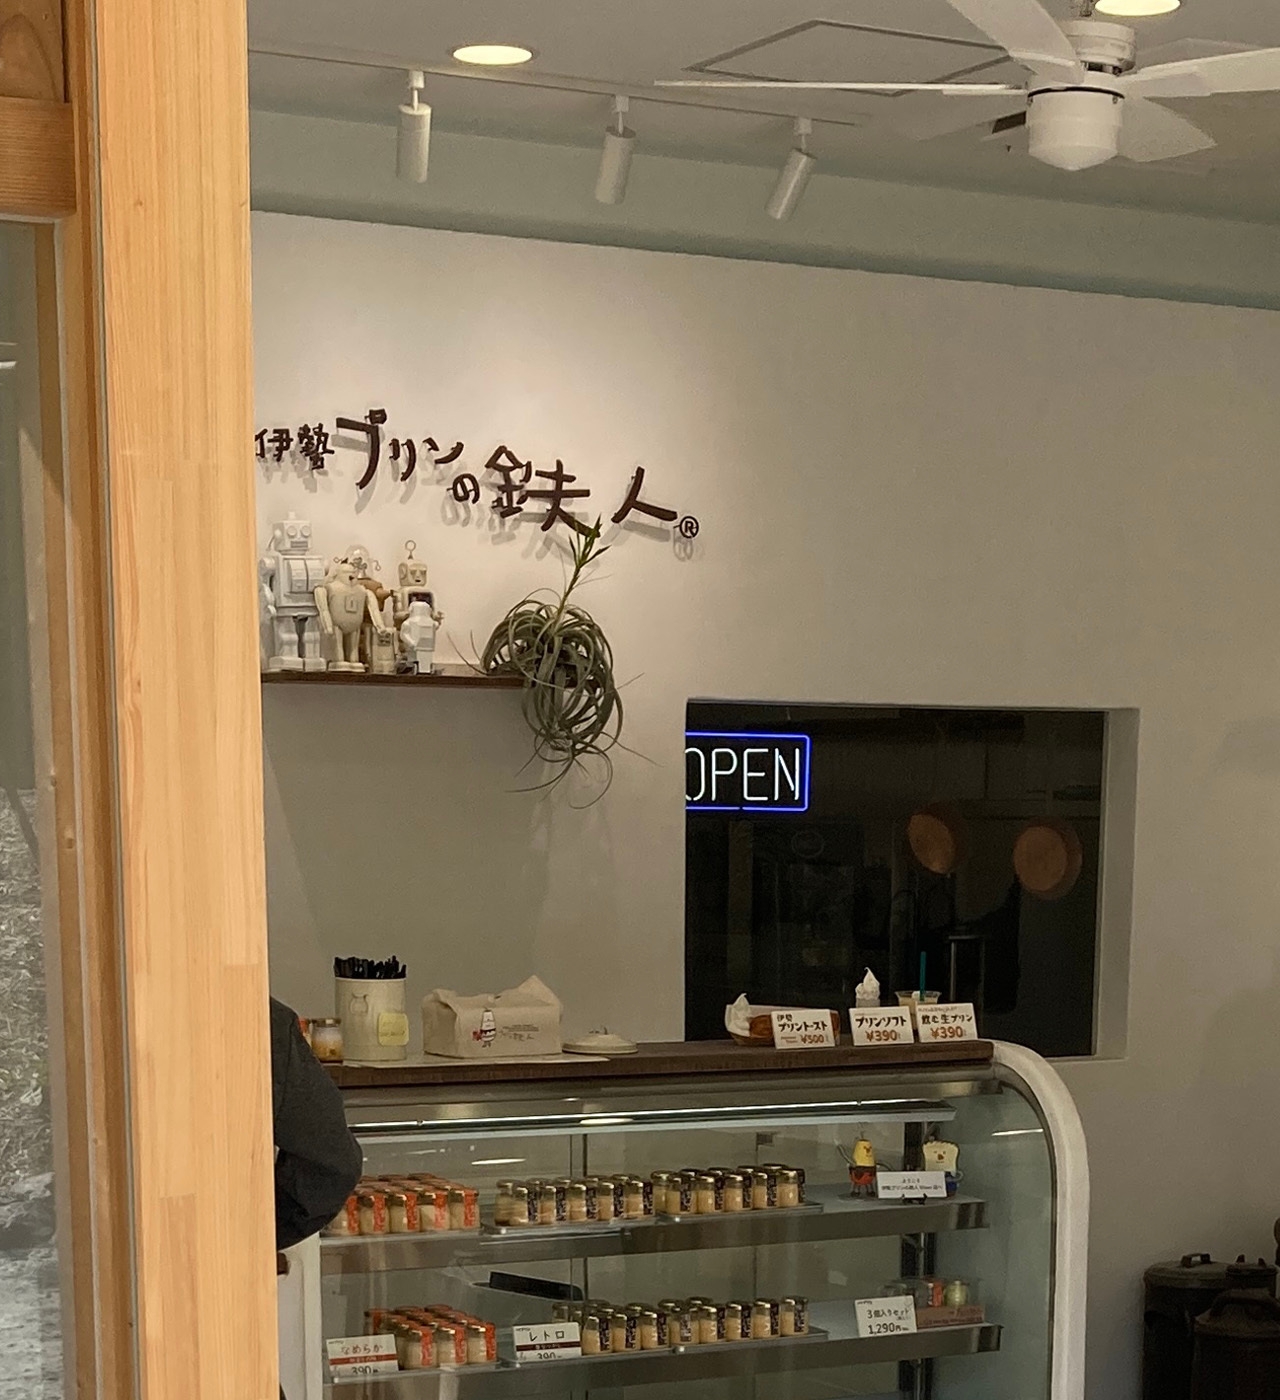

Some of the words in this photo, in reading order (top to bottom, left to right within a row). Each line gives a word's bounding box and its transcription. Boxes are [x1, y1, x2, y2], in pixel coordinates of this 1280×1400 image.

[685, 748, 800, 801] OPEN
[865, 1029, 897, 1042] ¥390
[930, 1026, 964, 1040] ¥390
[529, 1330, 565, 1341] レトロ
